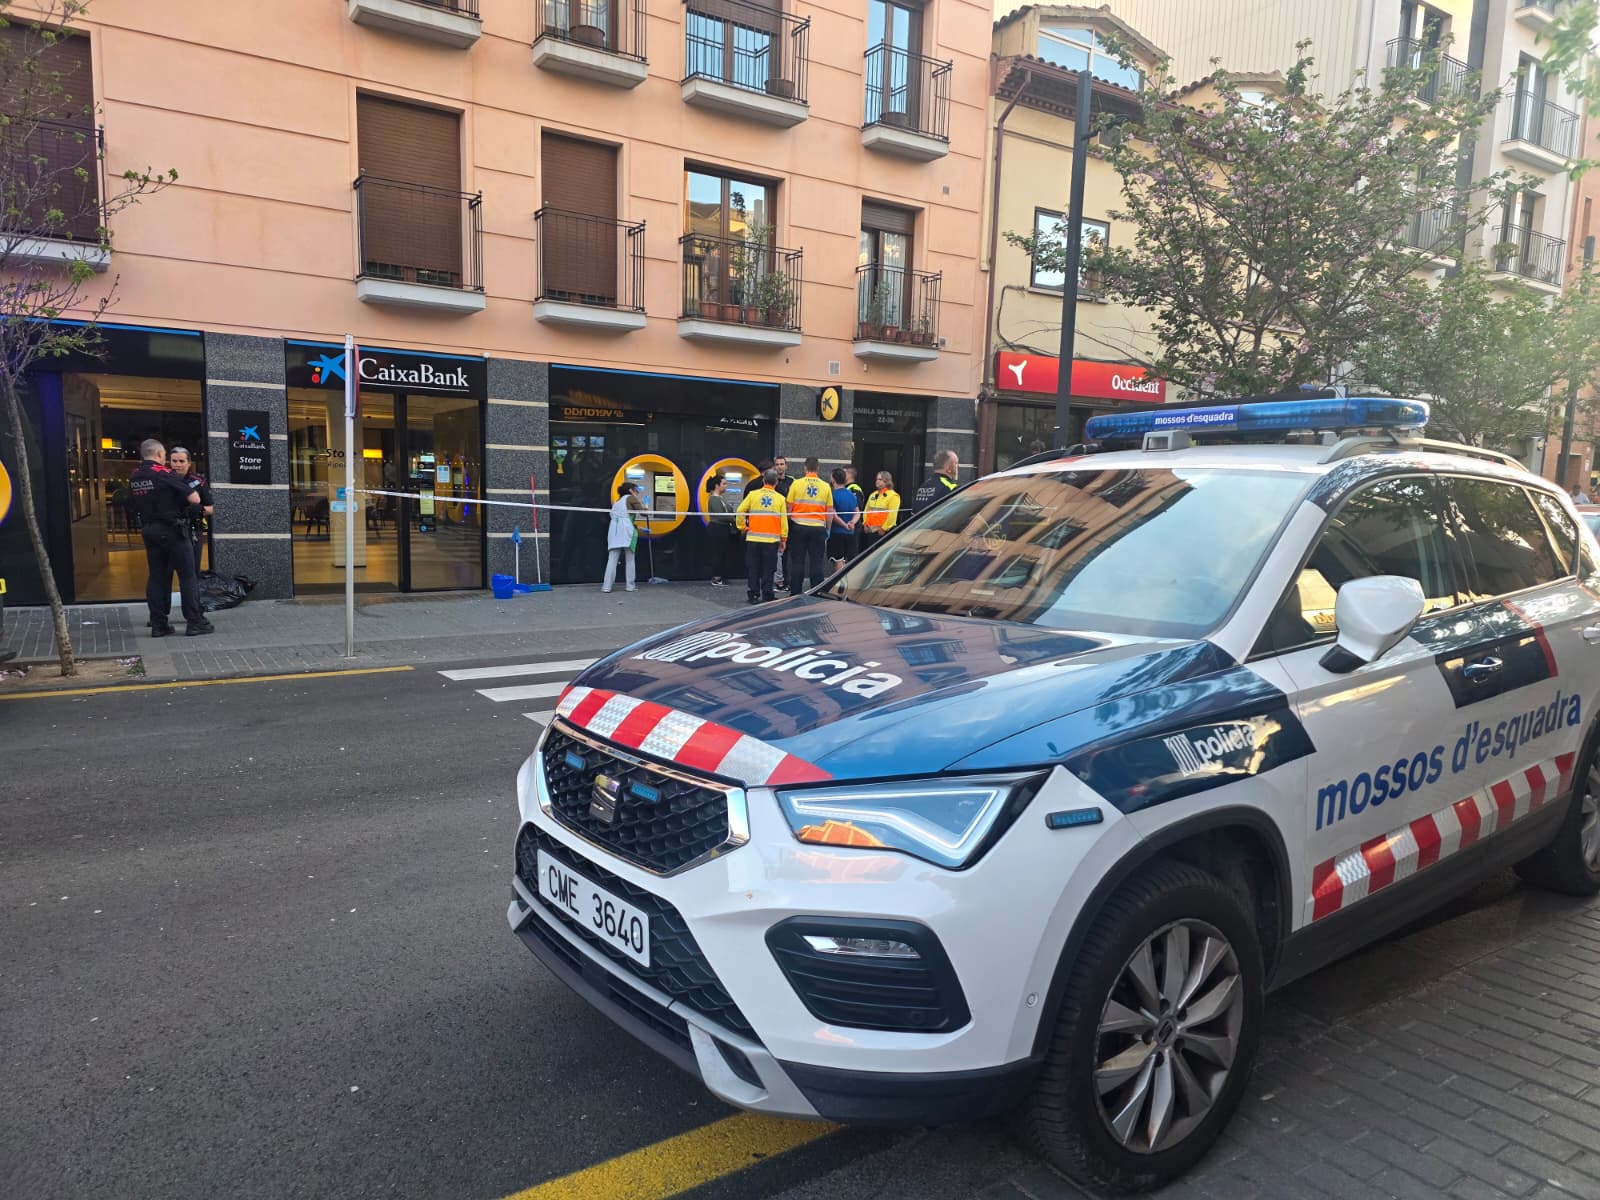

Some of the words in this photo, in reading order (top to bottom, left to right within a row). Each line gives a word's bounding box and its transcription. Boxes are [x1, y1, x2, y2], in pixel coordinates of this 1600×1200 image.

[359, 358, 470, 387] CaixaBank
[1154, 415, 1186, 426] mossos
[1187, 411, 1234, 425] d'esquadra
[239, 456, 262, 464] Store
[684, 641, 903, 699] policia
[1193, 723, 1255, 765] policia
[1315, 744, 1446, 832] mossos
[1451, 690, 1582, 774] d'esquadra
[548, 864, 580, 915] CME
[592, 892, 644, 955] 3640
